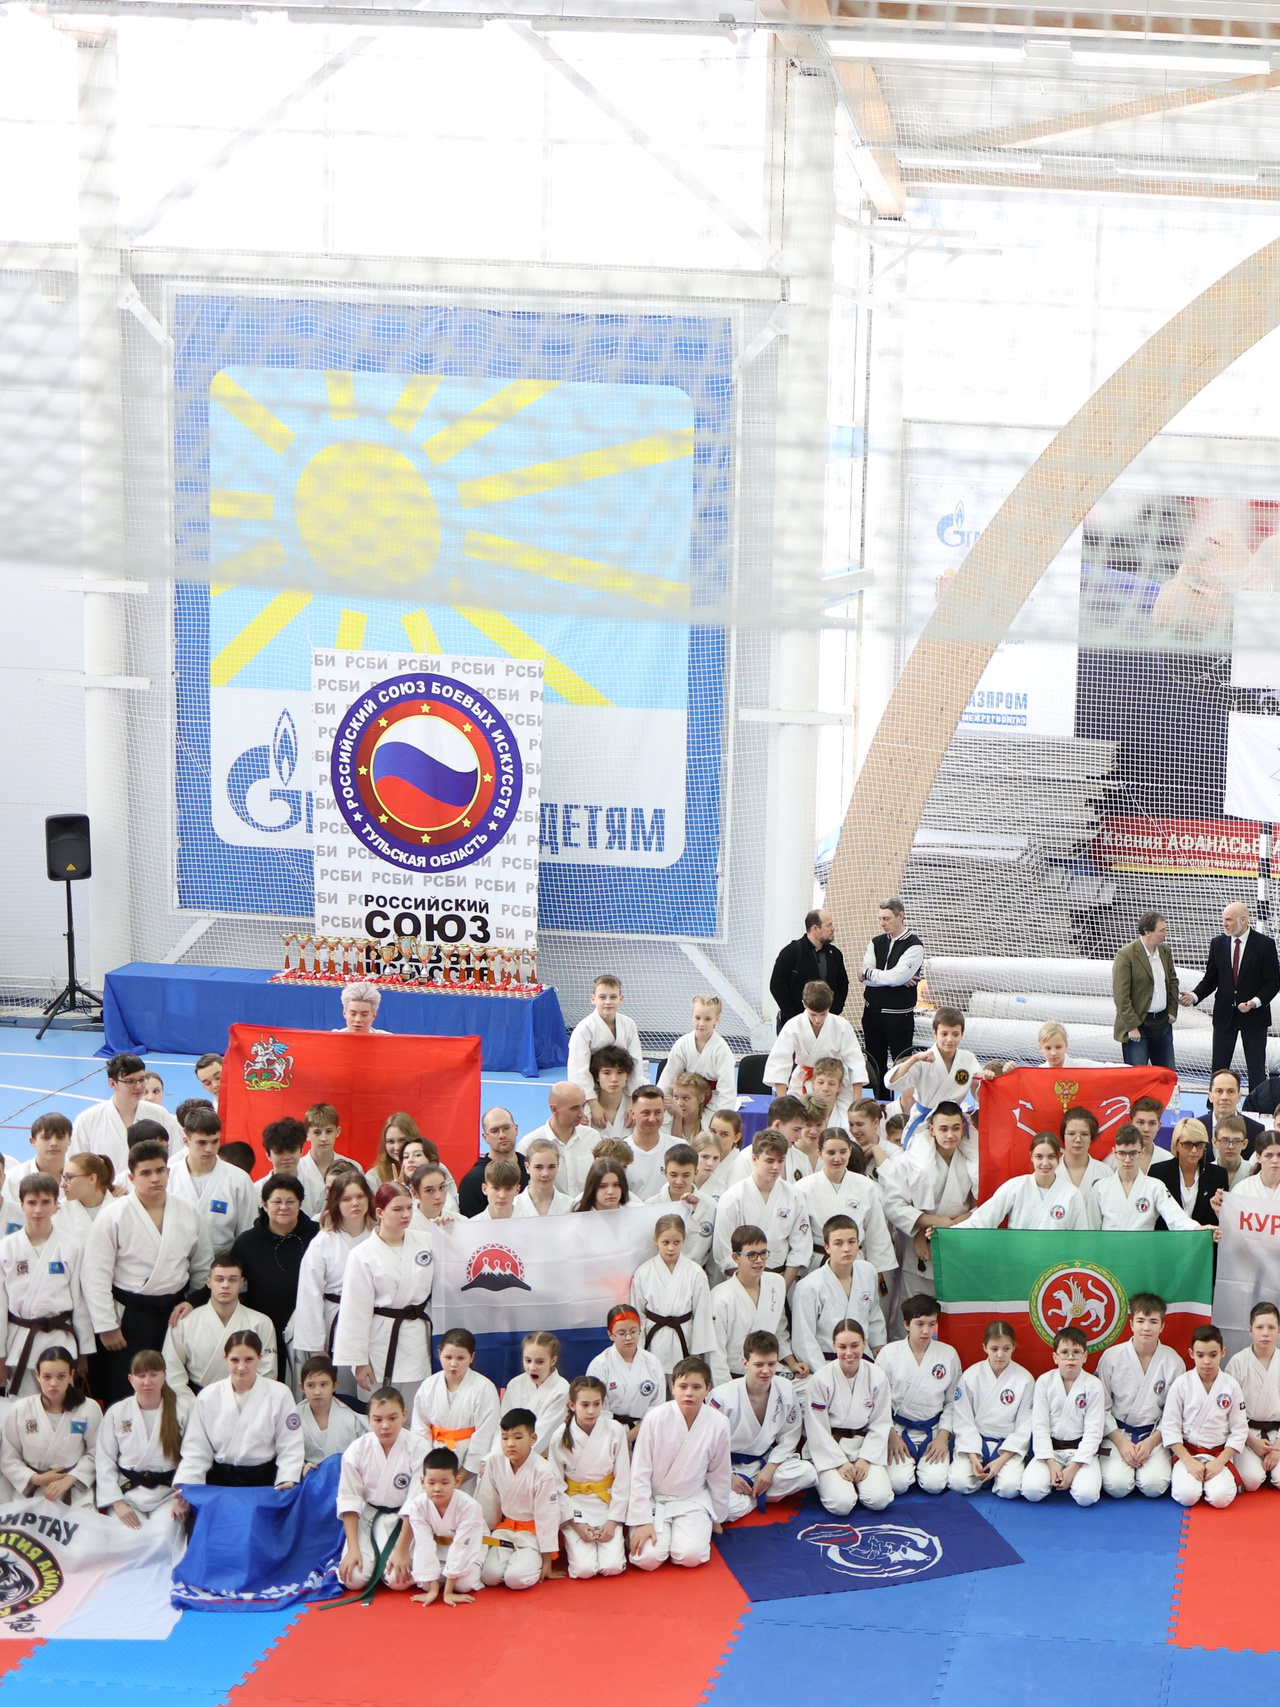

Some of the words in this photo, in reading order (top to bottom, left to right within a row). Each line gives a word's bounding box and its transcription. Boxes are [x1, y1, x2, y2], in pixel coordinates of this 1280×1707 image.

[312, 654, 336, 667] БИ
[345, 656, 388, 670] РСБИ
[398, 658, 441, 673] РСБИ
[451, 661, 495, 676] РСБИ
[318, 678, 360, 693] РСБИ
[312, 702, 336, 715] БИ
[968, 691, 1028, 710] АЗПРОМ
[338, 698, 378, 811] РОССИЙСКИЙ
[377, 680, 426, 704] СОЮЗ
[431, 681, 497, 730] БОЕВЫХ
[490, 728, 515, 820] ИСКУССТВ
[539, 803, 666, 855] ДЕТЯМ
[315, 845, 337, 858] БИ
[361, 822, 427, 868] ТУЛЬСКАЯ
[429, 833, 489, 868] ОБЛАСТЬ
[320, 869, 362, 883] РСБИ
[372, 871, 414, 886] РСБИ
[423, 874, 467, 889] РСБИ
[475, 878, 516, 893] РСБИ
[316, 892, 338, 905] БИ
[364, 894, 489, 915] РОССИЙСКИЙ
[321, 915, 363, 930] РСБИ
[365, 910, 491, 944] СОЮЗ
[0, 1512, 79, 1546] ИРТАУ
